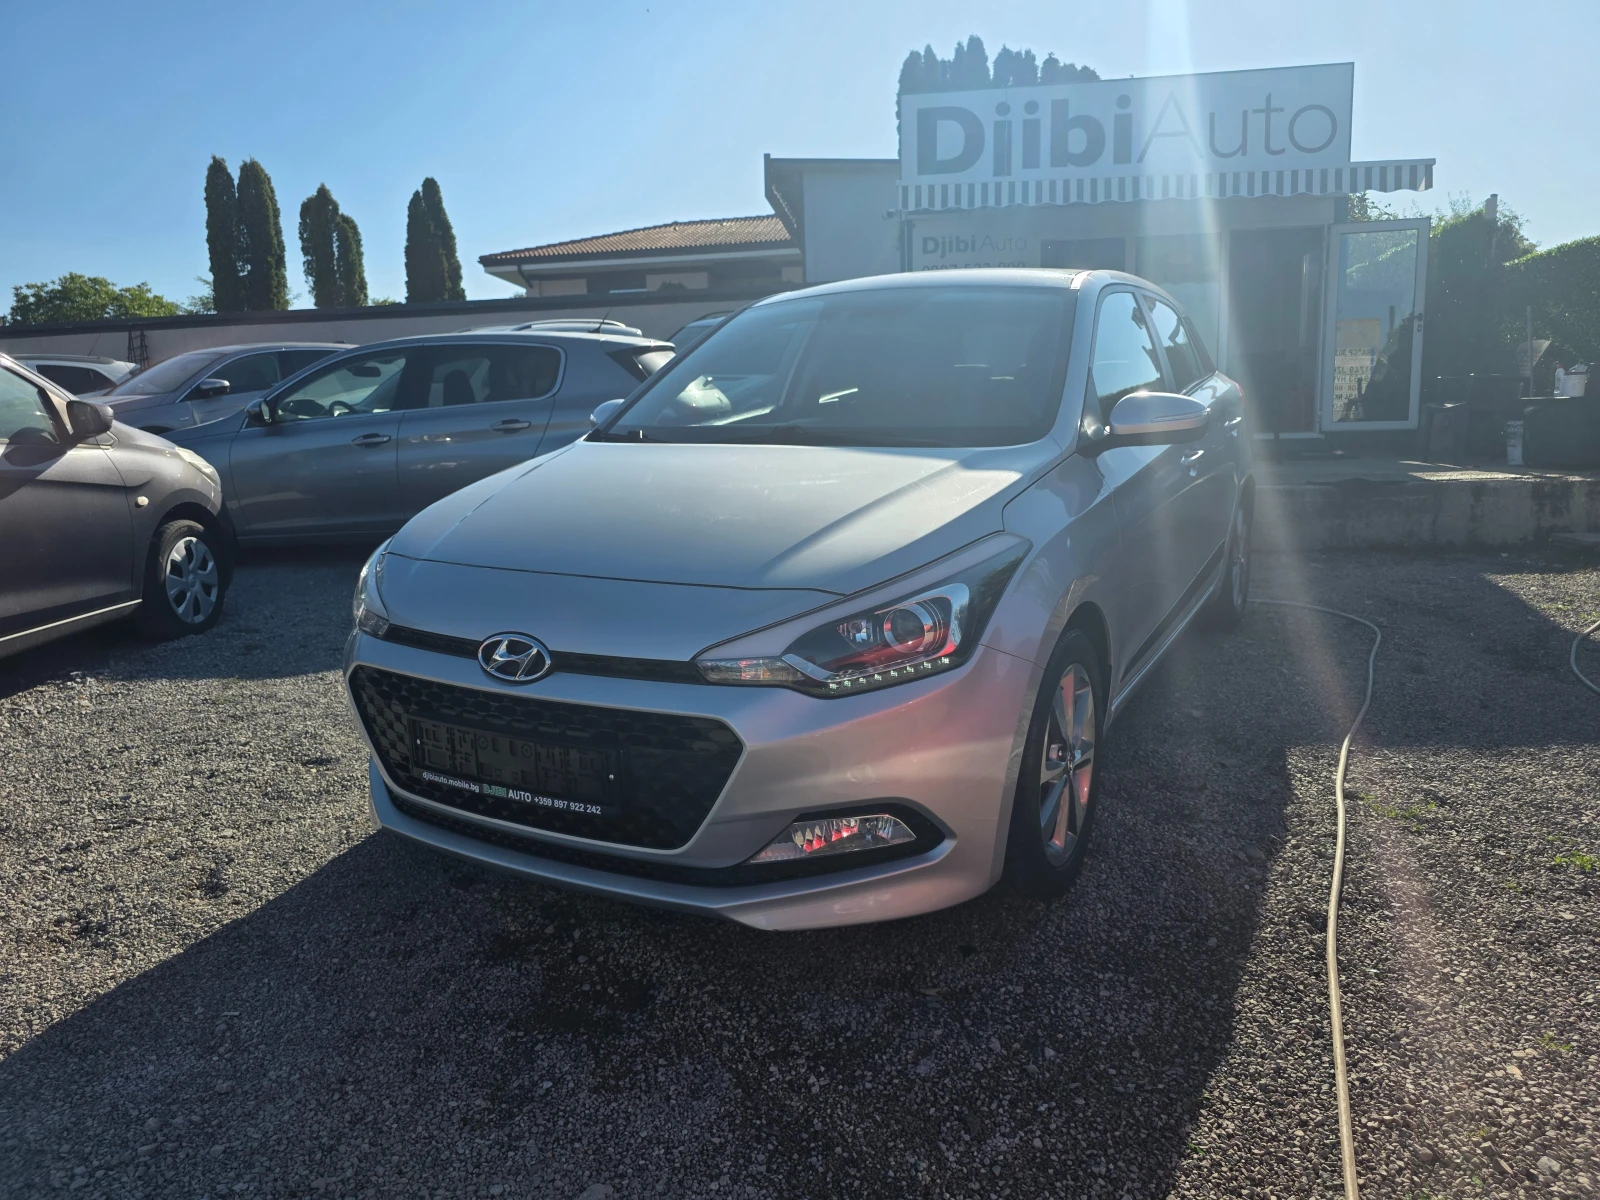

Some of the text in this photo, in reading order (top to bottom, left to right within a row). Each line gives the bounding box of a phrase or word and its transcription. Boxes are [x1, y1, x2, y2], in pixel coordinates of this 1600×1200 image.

[422, 771, 602, 815] djibiauto.mobile.bg DJIBI AUTO +359 897 922 242
